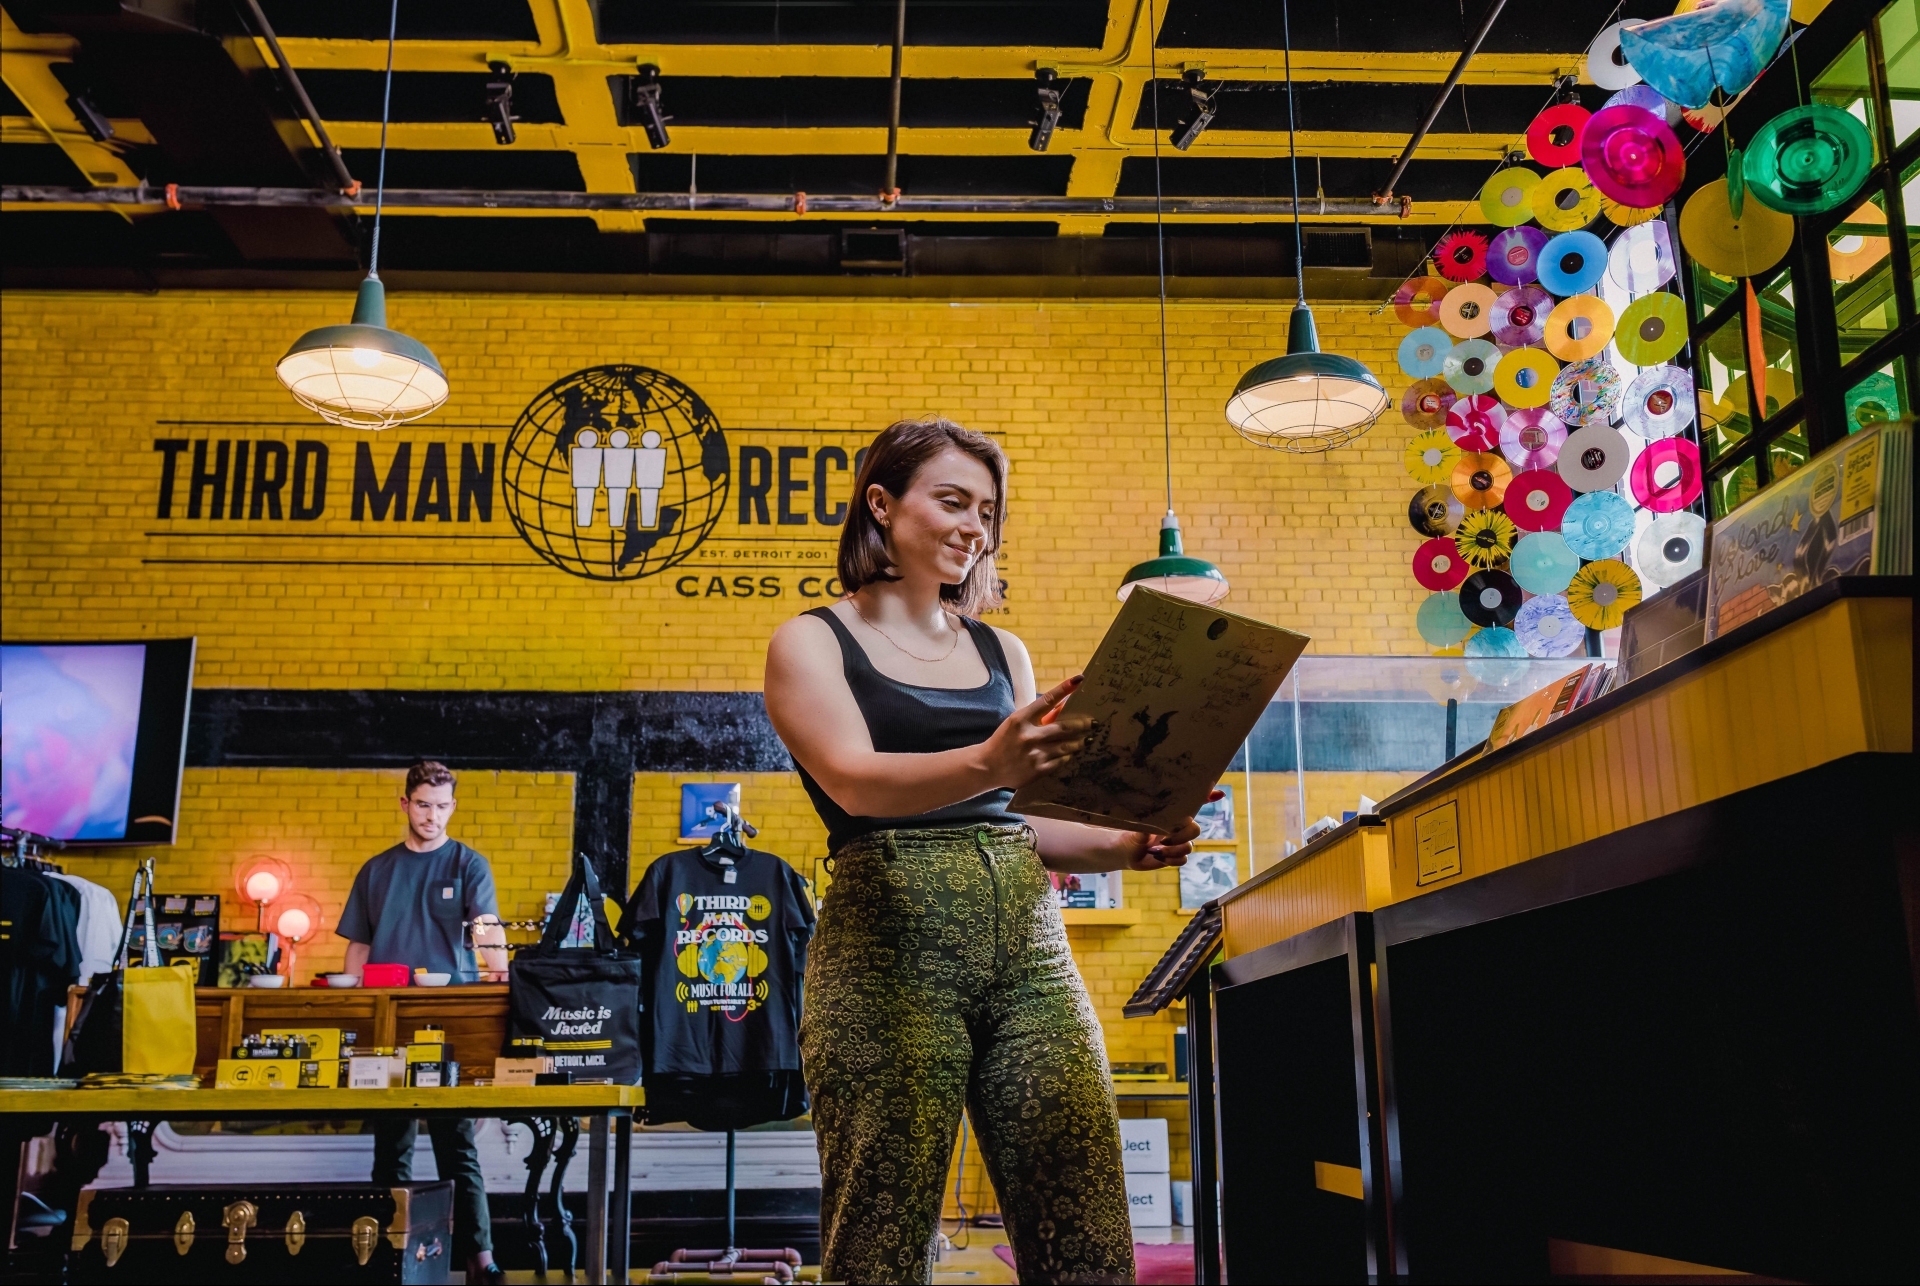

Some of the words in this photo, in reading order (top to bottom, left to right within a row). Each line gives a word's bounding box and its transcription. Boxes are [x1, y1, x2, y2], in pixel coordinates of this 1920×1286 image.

[153, 438, 329, 522] THIRD
[351, 441, 496, 523] MAN
[700, 550, 728, 558] EST.
[733, 550, 791, 559] DETROIT
[797, 551, 828, 559] 2001
[1736, 540, 1779, 585] love
[676, 576, 781, 598] CASS
[693, 895, 752, 910] THIRD
[702, 912, 744, 926] MAN
[676, 927, 769, 944] RECORDS
[690, 983, 718, 998] MUSIC
[720, 983, 737, 997] FOR
[737, 982, 754, 996] ALL
[541, 1006, 596, 1021] Music
[597, 1005, 612, 1019] is
[550, 1020, 603, 1035] Sacred
